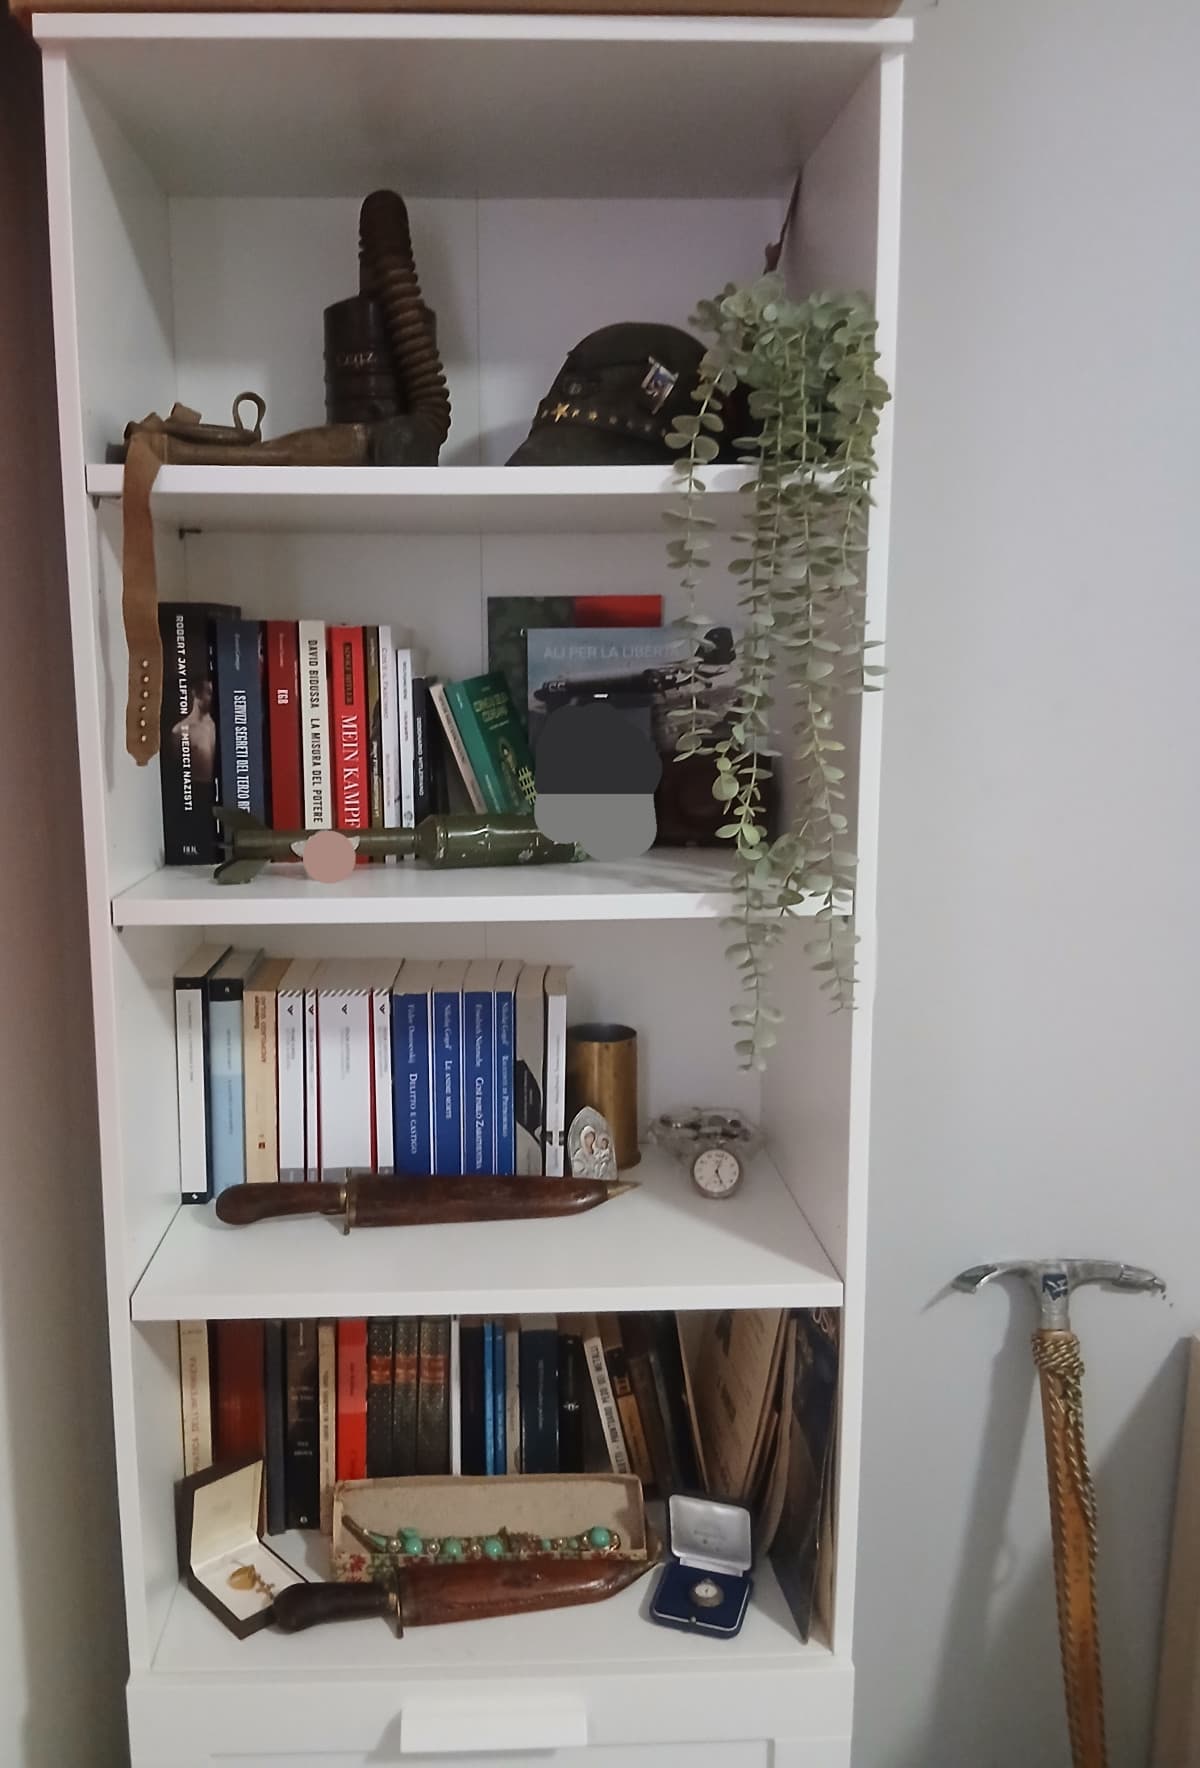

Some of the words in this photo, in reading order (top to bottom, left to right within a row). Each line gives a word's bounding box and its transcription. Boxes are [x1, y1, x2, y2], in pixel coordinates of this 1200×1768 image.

[175, 615, 185, 655] ROBERT
[178, 657, 186, 675] JAY
[308, 639, 319, 666] DAVID
[568, 645, 597, 658] PER
[601, 645, 619, 658] LA
[179, 678, 188, 714] LIFTON
[277, 689, 289, 705] KGB
[308, 669, 320, 709] BIDUSSA
[233, 695, 247, 724] SERVIZI
[310, 718, 321, 729] LA
[181, 732, 191, 768] MEDICI
[234, 726, 248, 758] SEGRETI
[311, 732, 322, 766] MISURA
[341, 715, 359, 762] MEIN
[236, 760, 249, 775] DEL
[312, 770, 322, 787] DEL
[183, 770, 192, 811] NAZISTI
[236, 776, 249, 799] TERZO
[343, 766, 360, 829] KAMPF
[312, 789, 323, 823] POTERE
